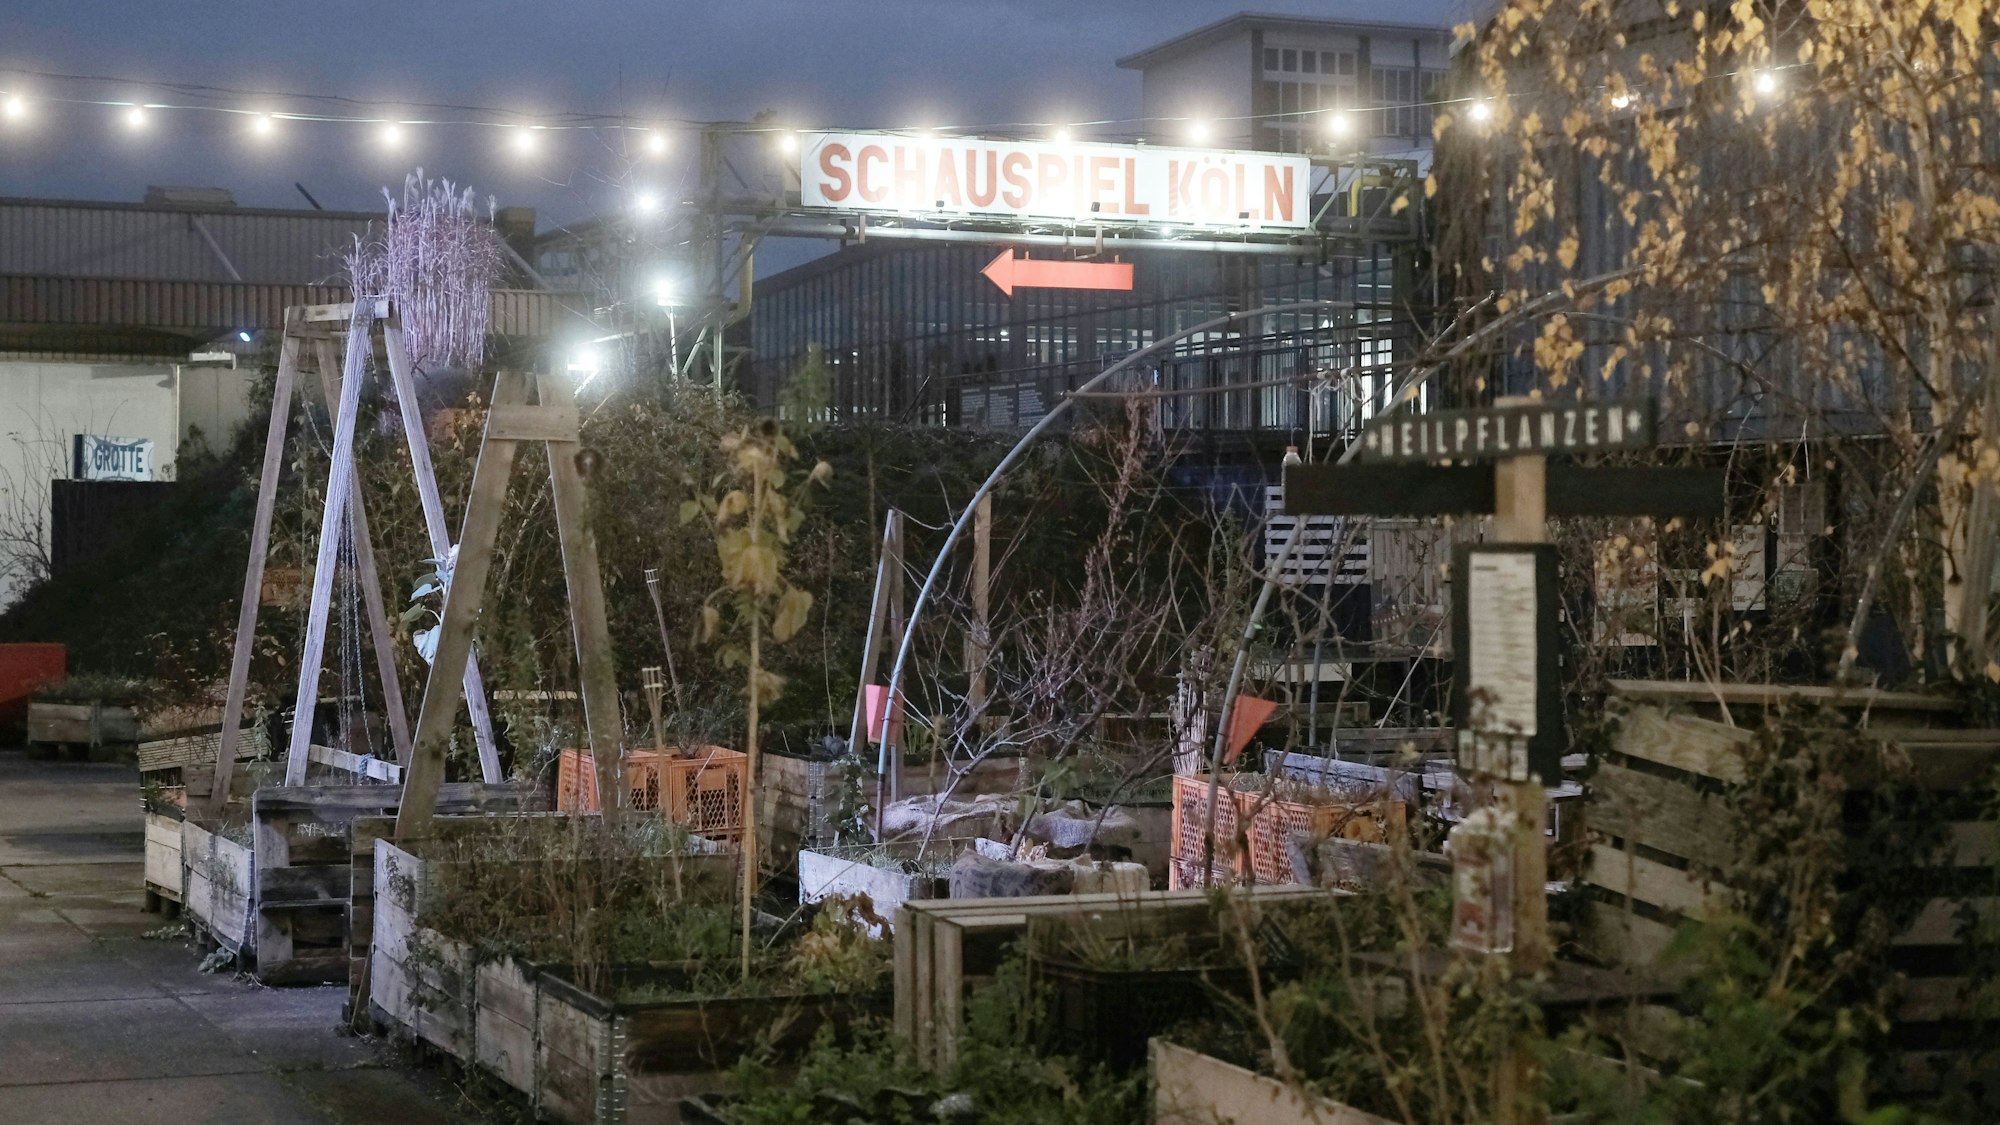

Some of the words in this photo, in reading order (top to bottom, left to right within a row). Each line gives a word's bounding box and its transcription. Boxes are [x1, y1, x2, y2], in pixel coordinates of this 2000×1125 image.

[819, 142, 1150, 215] SCHAUSPIEL
[1168, 155, 1294, 222] KÖLN
[95, 445, 143, 472] GROTTE
